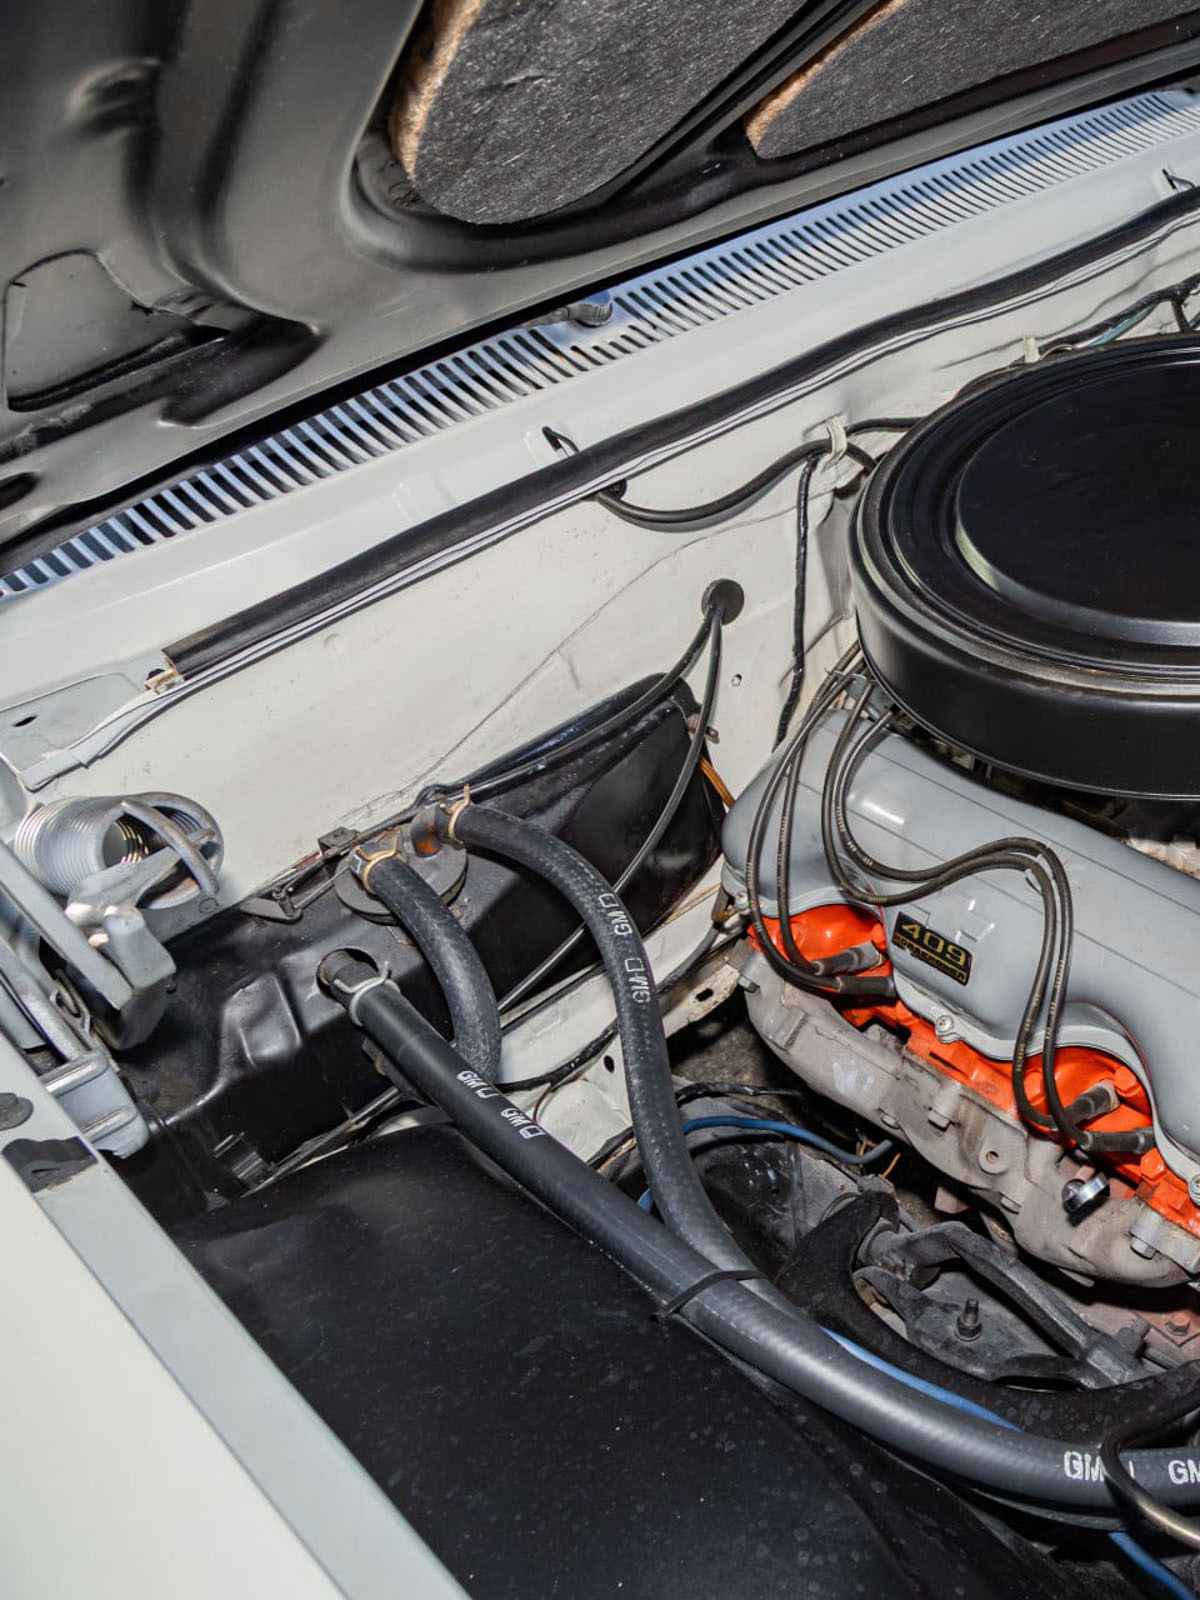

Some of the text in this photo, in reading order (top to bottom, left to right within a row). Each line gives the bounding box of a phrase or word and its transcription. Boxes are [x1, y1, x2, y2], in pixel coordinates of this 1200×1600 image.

[607, 910, 633, 936] GM
[902, 924, 967, 967] 409
[629, 975, 650, 1003] GM
[456, 1070, 488, 1089] GM
[500, 1107, 533, 1127] GM
[1064, 1451, 1106, 1482] GM
